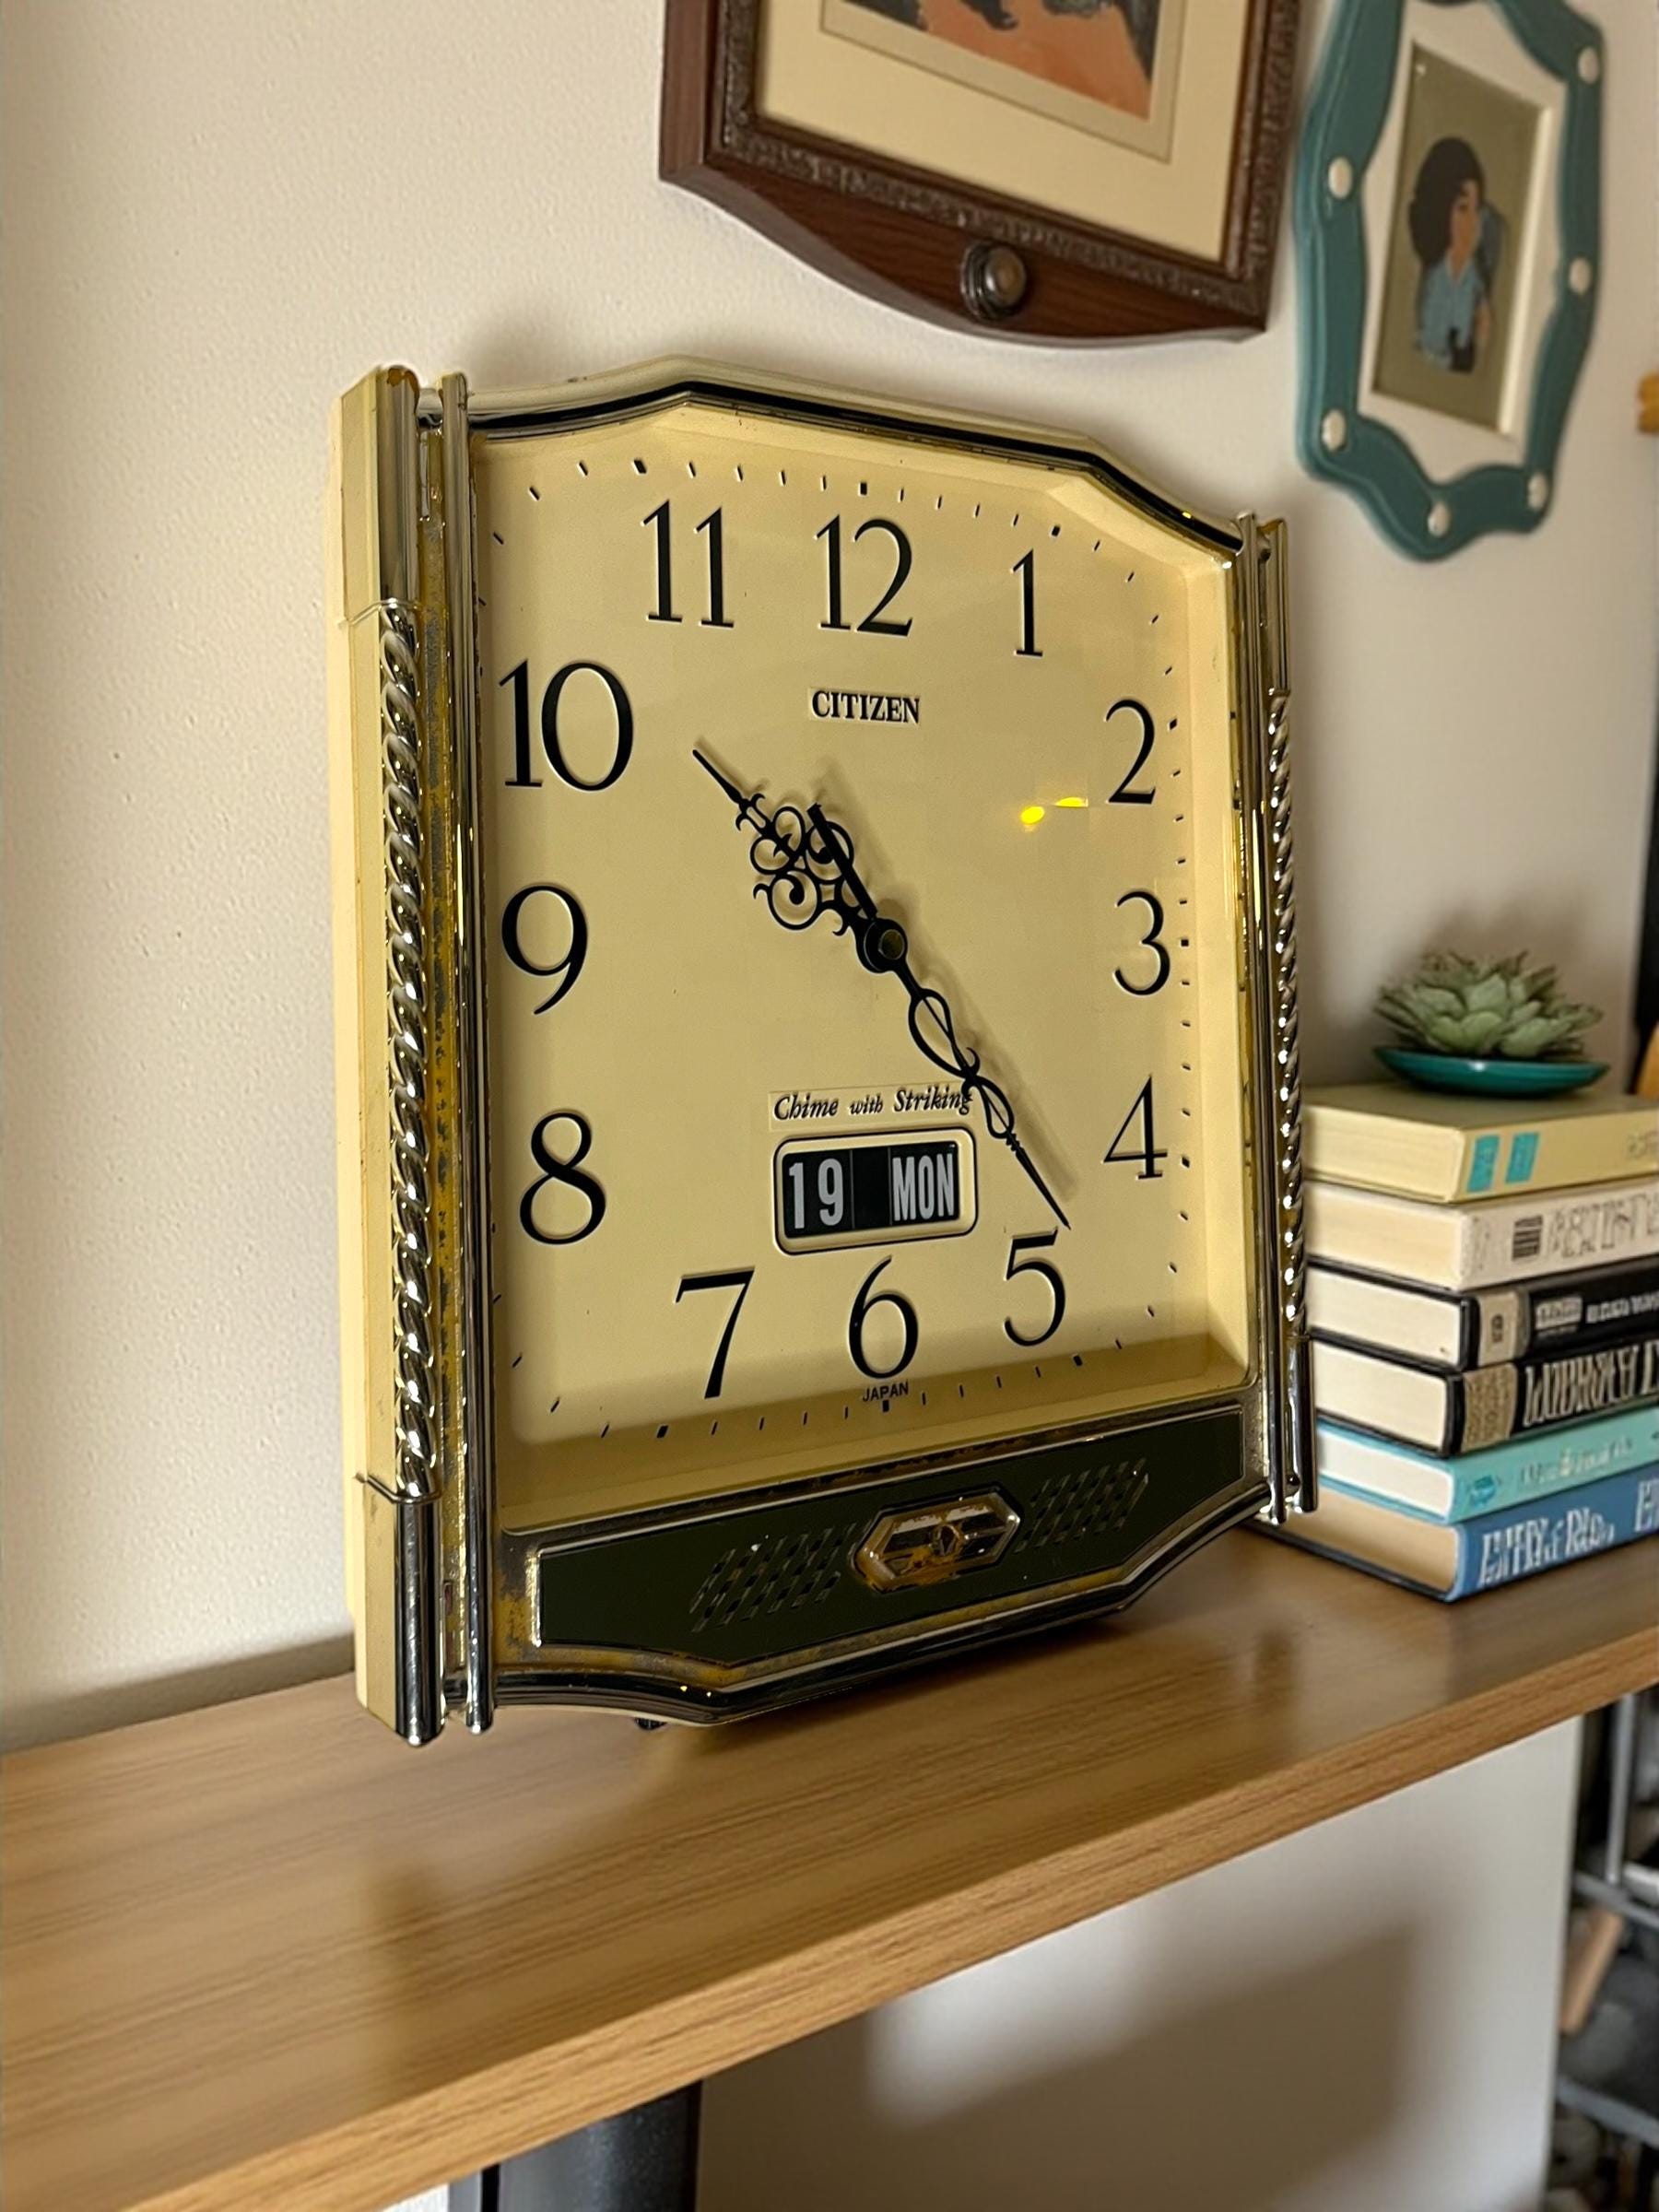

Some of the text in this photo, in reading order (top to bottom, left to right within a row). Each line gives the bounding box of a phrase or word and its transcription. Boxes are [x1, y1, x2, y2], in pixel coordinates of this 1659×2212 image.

[642, 499, 735, 628] 11
[816, 514, 913, 637] 12
[1012, 549, 1043, 657] 1
[499, 659, 634, 792] 10
[812, 690, 920, 724] CITIZEN
[1105, 699, 1156, 805] 2
[501, 885, 588, 1015] 9
[1113, 891, 1171, 996] 3
[774, 1085, 972, 1121] Chime with Striking
[1103, 1074, 1169, 1180] 4
[519, 1112, 606, 1245] 8
[789, 1153, 954, 1229] 19 MON
[675, 1266, 755, 1399] 7
[849, 1256, 918, 1379] 6
[1004, 1227, 1065, 1347] 5
[863, 1382, 909, 1402] JAPAN
